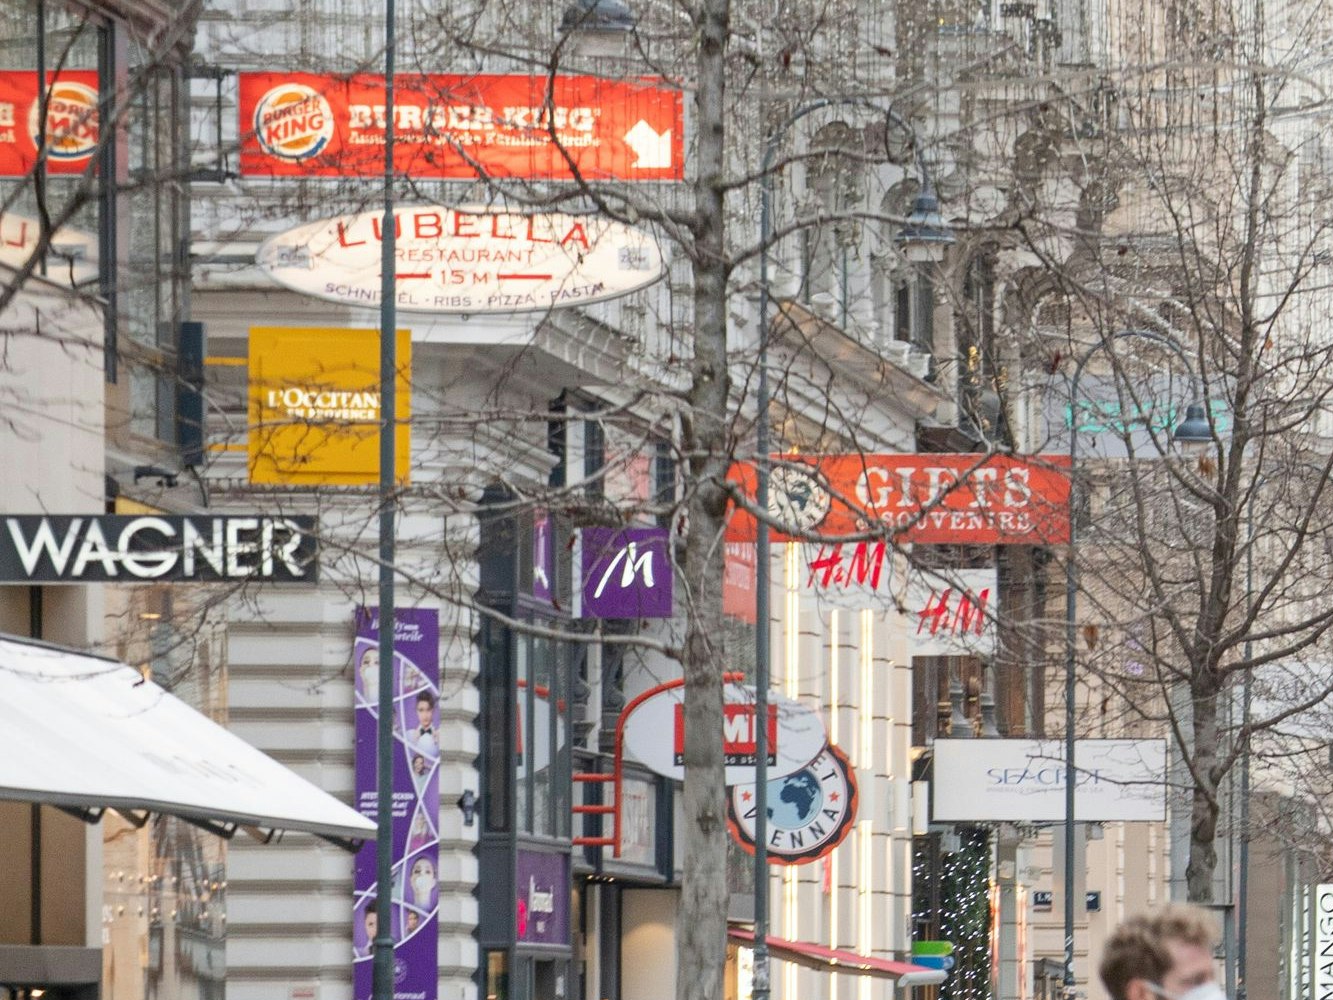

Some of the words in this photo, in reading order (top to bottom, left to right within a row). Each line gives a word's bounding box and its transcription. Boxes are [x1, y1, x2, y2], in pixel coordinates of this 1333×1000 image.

[264, 97, 321, 124] BURGER
[349, 105, 494, 129] BURGER
[503, 106, 595, 131] KING
[267, 113, 323, 144] KING
[337, 211, 590, 250] LUBELLA
[394, 248, 534, 264] RESTAURANT
[441, 270, 468, 285] 15
[472, 271, 489, 285] M
[325, 281, 418, 305] SCHNIEL
[434, 290, 471, 306] RIBS
[488, 289, 534, 306] PIZZA
[268, 387, 381, 408] L'OCCITAN
[856, 466, 1031, 510] GIFTS
[6, 517, 304, 578] WAGNER
[808, 543, 887, 591] H&M
[917, 588, 989, 637] H&M
[986, 767, 1104, 785] SEACRT
[743, 806, 840, 849] VENNA
